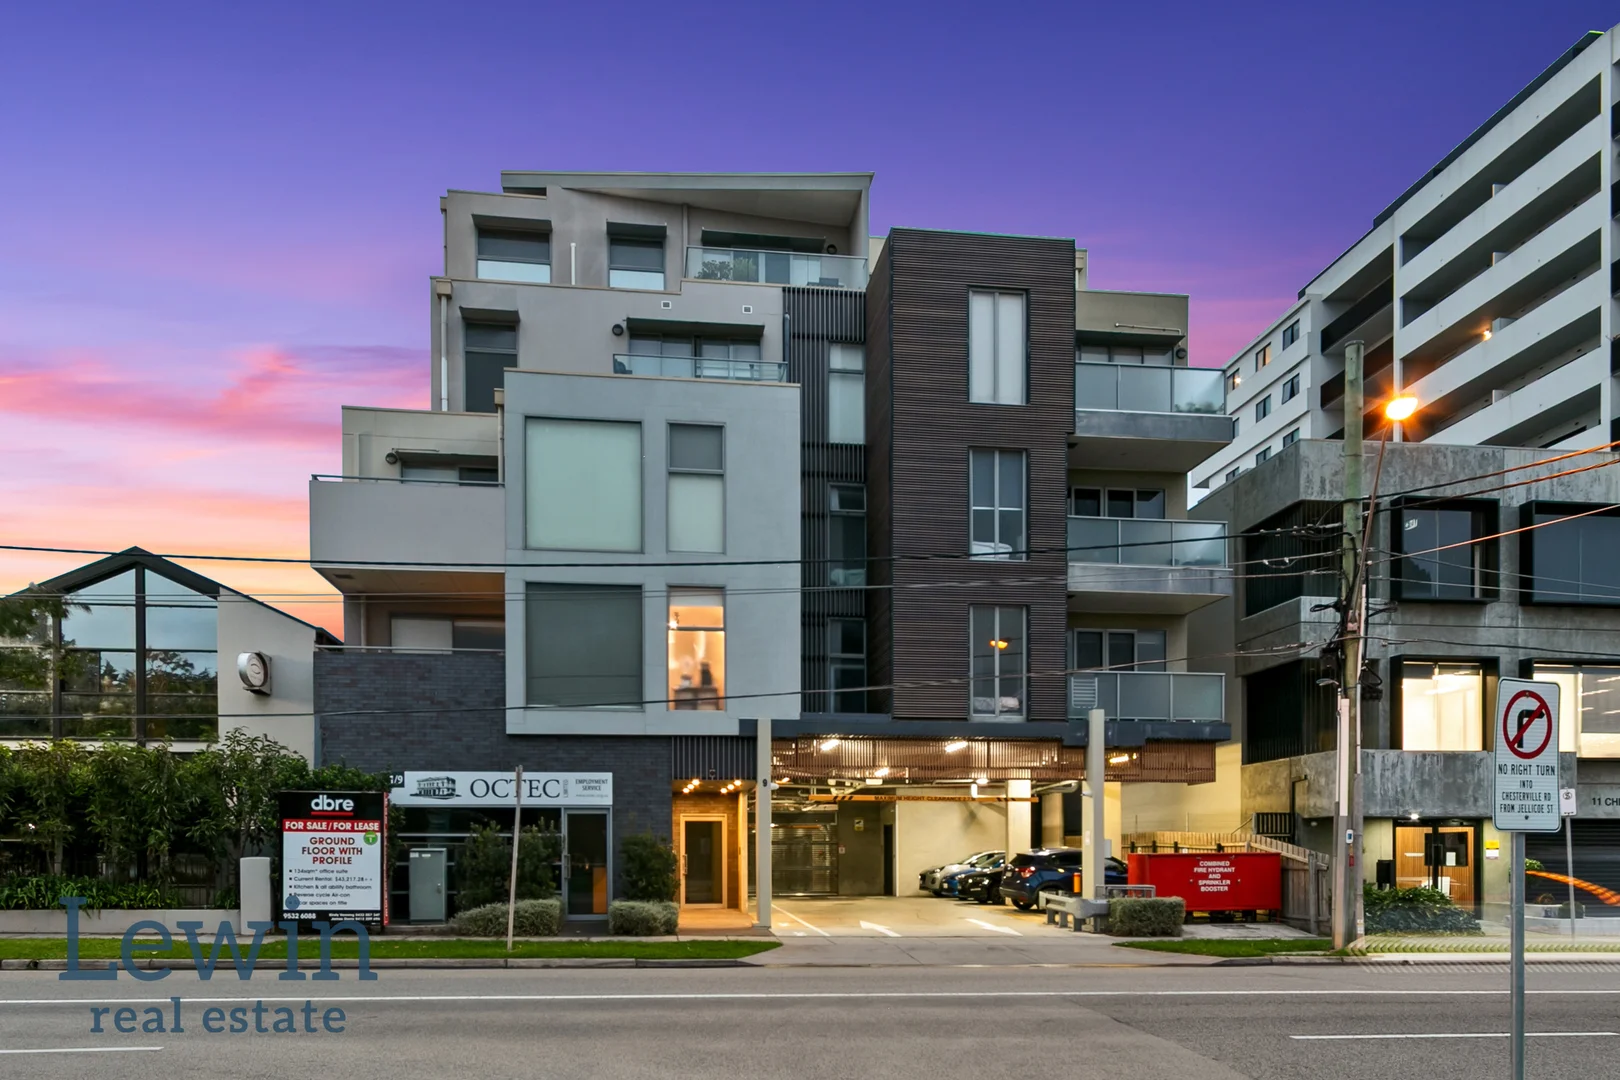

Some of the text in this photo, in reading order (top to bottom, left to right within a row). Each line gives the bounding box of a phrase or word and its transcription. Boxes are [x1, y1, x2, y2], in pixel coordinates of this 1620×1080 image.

[1498, 764, 1556, 776] NO RIGHT TURN
[762, 778, 767, 787] 9
[1520, 780, 1533, 789] INTO
[1502, 792, 1551, 801] CHESTERVILLE RD
[311, 795, 354, 811] dbre
[1592, 797, 1620, 806] 11 CH
[1500, 804, 1553, 813] FROM JELLICOE ST
[306, 822, 327, 830] SALE
[333, 822, 352, 830] FOR
[354, 822, 379, 830] LEASE
[310, 837, 355, 845] GROUND
[302, 847, 362, 855] FLOOR WITH
